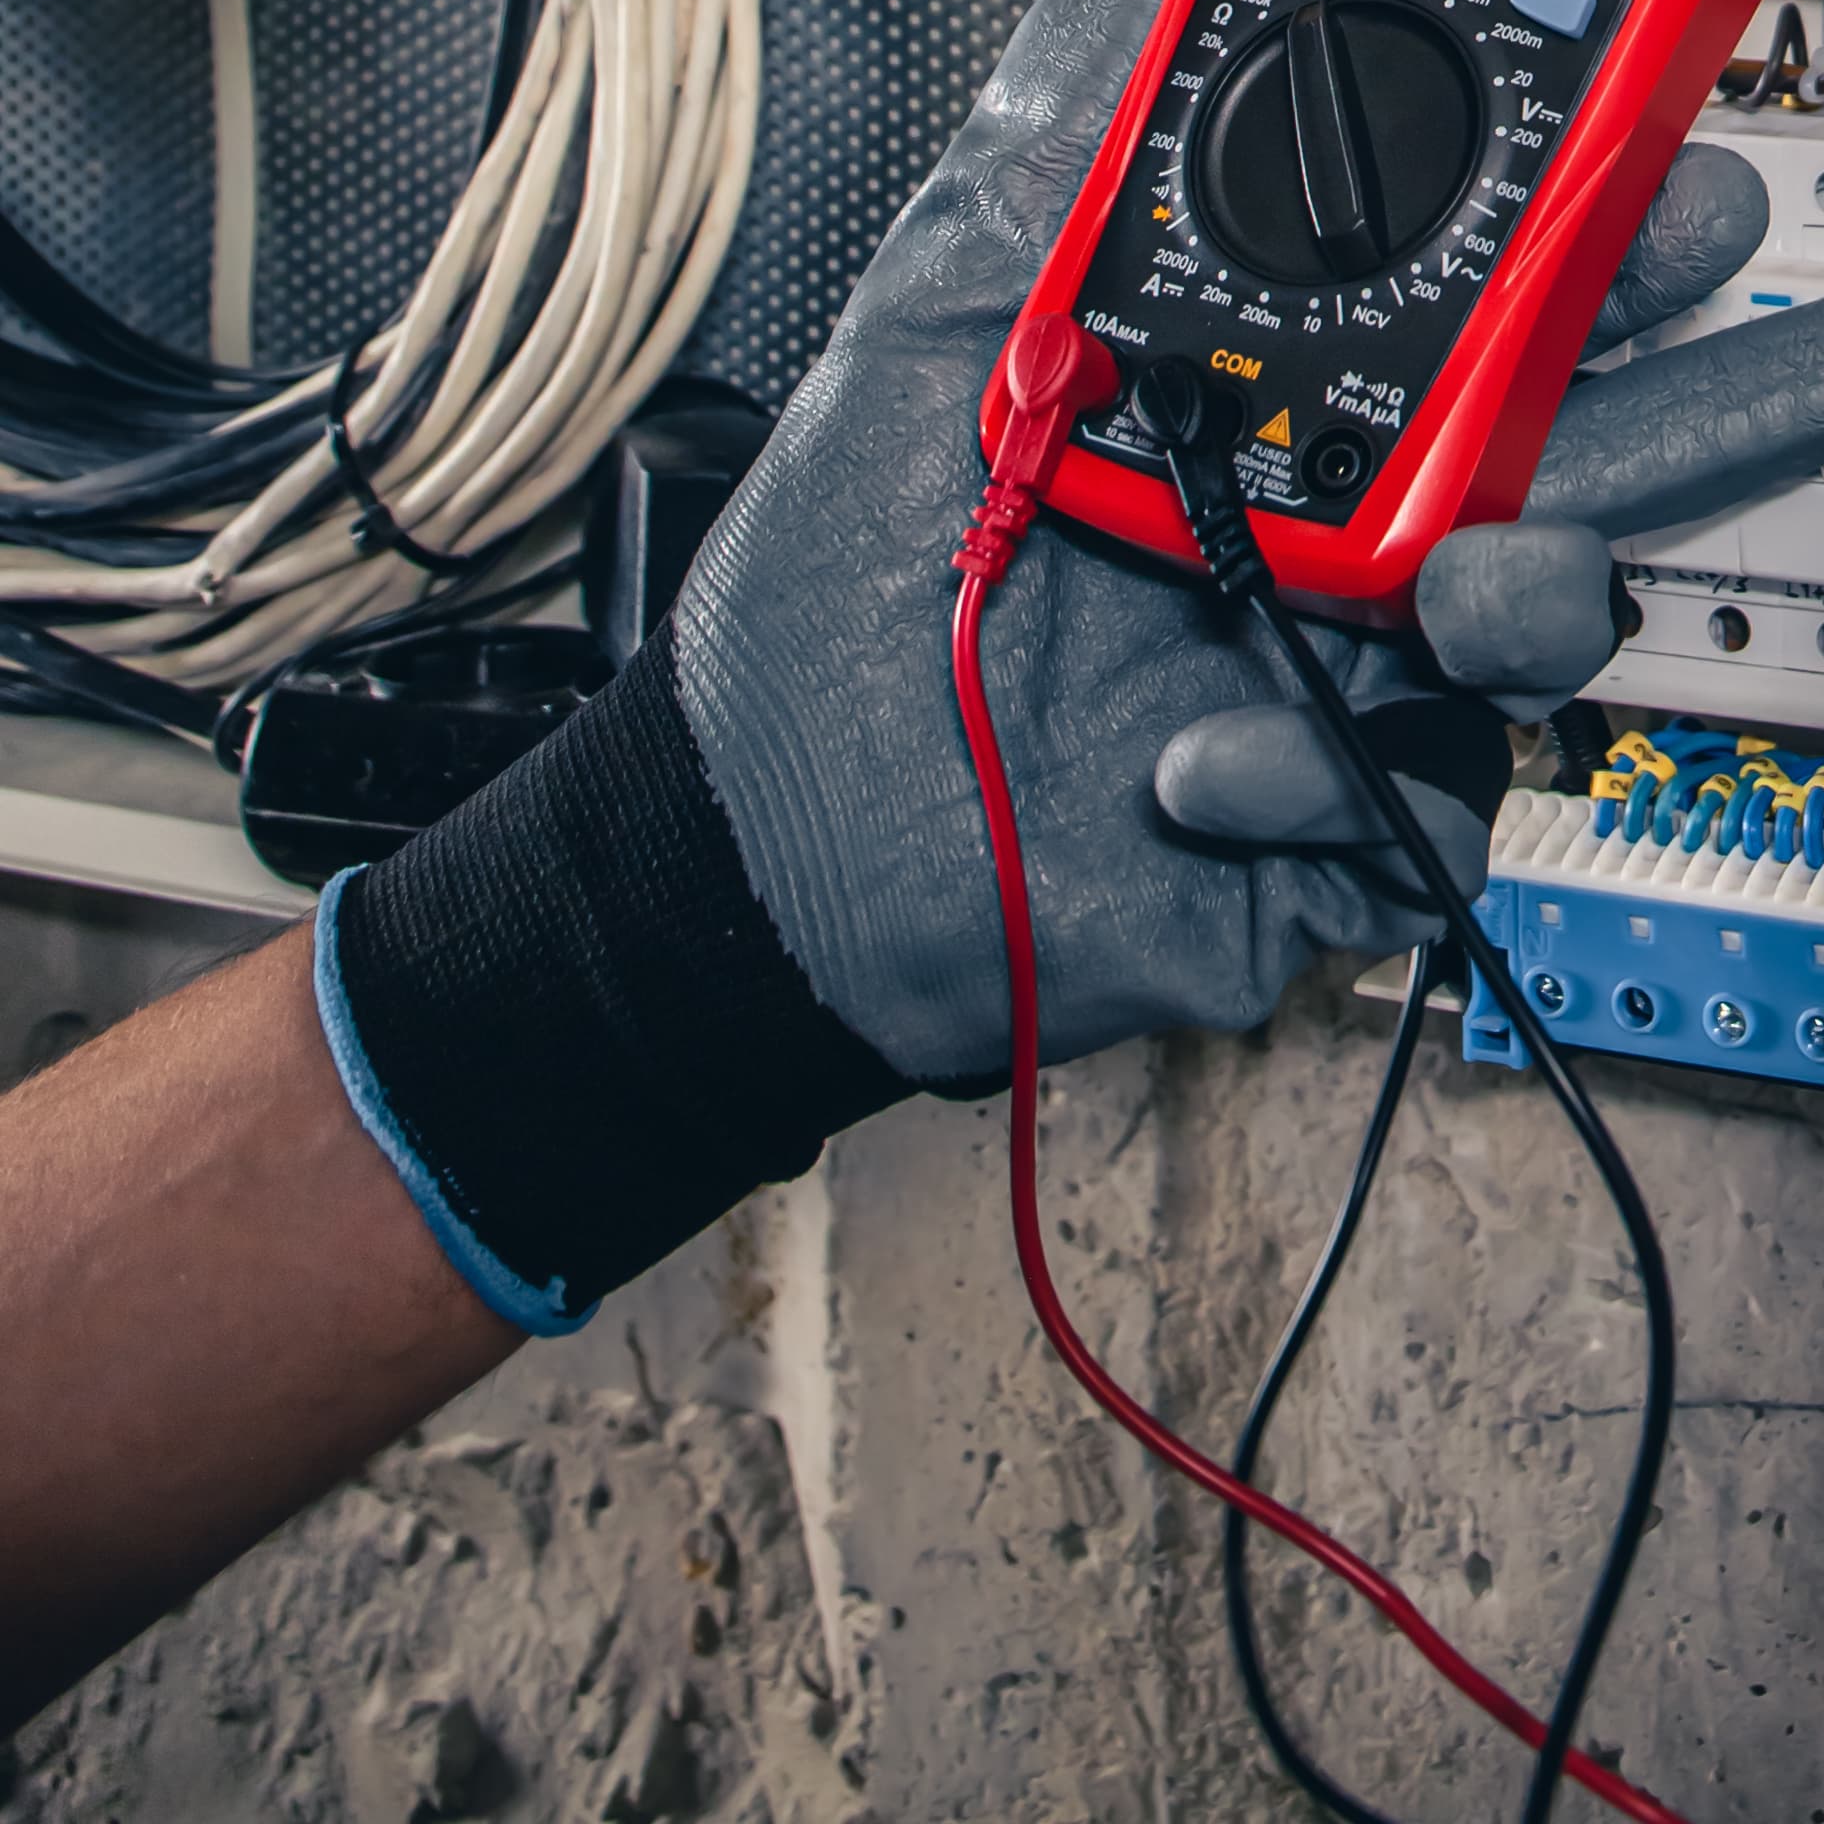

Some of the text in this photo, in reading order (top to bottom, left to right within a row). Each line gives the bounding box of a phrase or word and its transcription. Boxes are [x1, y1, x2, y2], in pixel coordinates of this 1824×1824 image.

[1211, 2, 1234, 27] Ω
[1198, 31, 1224, 50] 20k
[1490, 22, 1544, 49] 2000m
[1171, 71, 1204, 90] 2000
[1510, 69, 1534, 88] 20
[1148, 131, 1176, 151] 200
[1510, 127, 1543, 150] 200
[1495, 180, 1528, 203] 600
[1464, 233, 1496, 256] 600
[1199, 283, 1233, 306] 20m
[1409, 279, 1442, 302] 200
[1239, 303, 1282, 330] 200m
[1303, 314, 1323, 334] 10
[1352, 303, 1391, 330] NCV
[1210, 349, 1264, 381] COM
[1250, 442, 1292, 465] FUSED
[1269, 463, 1293, 481] Max
[1262, 476, 1292, 495] 600V
